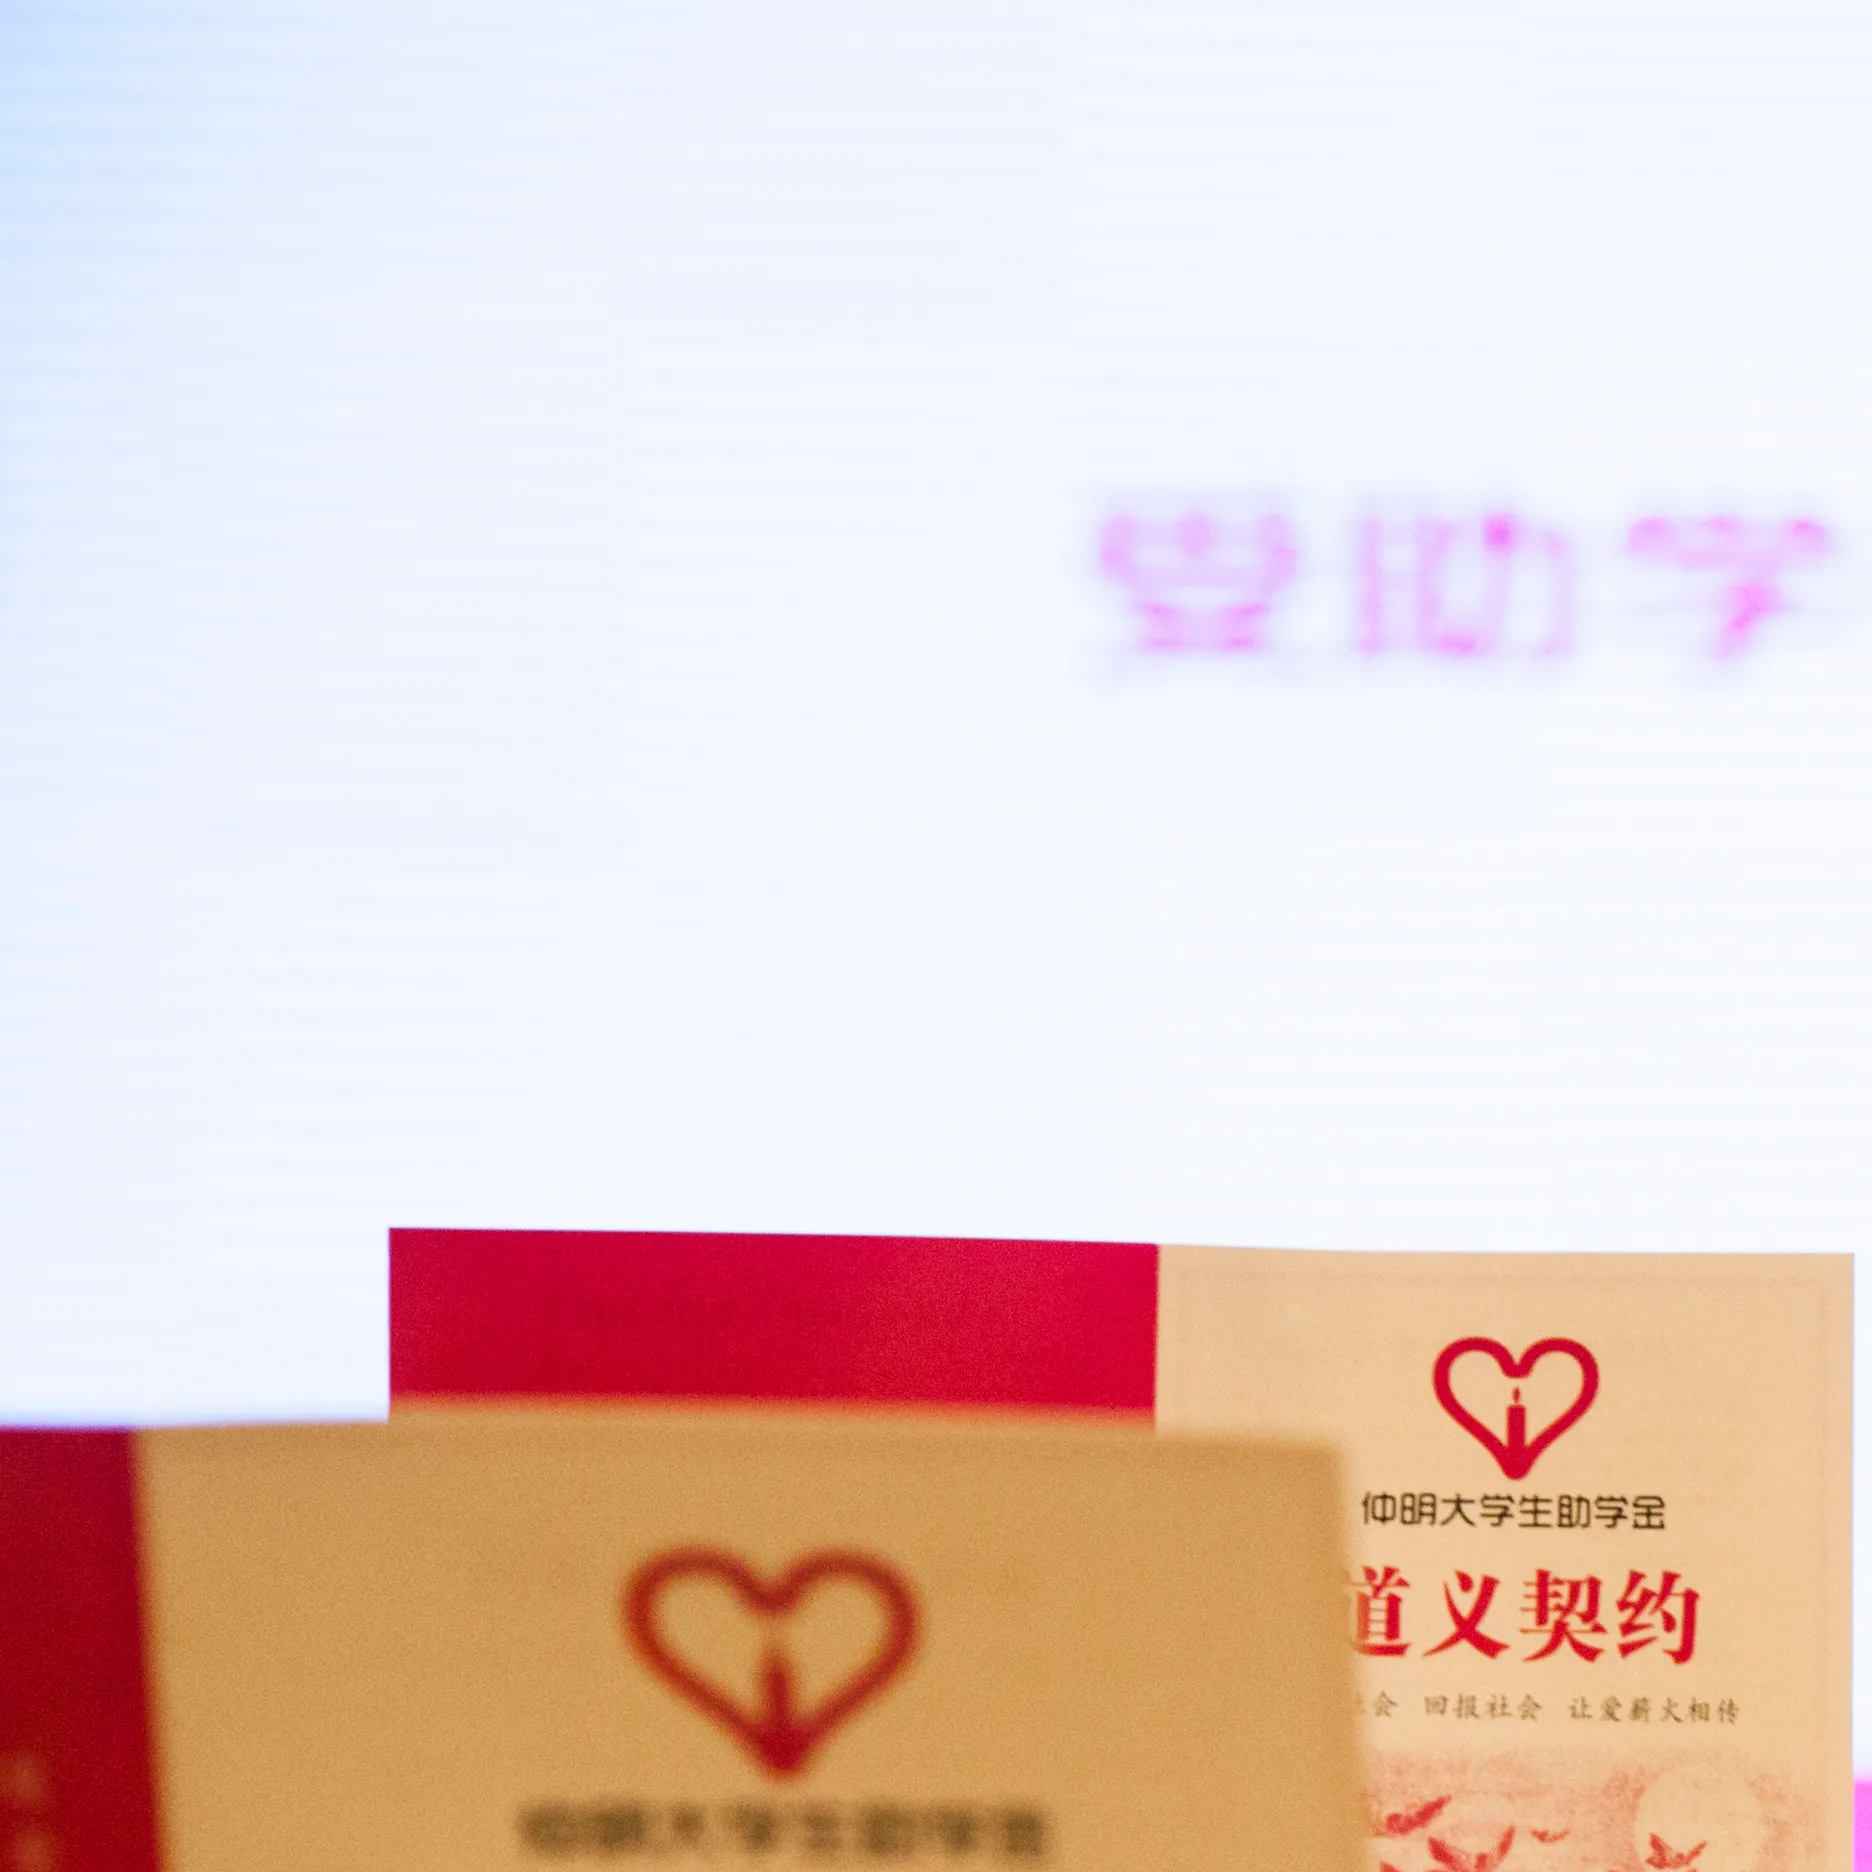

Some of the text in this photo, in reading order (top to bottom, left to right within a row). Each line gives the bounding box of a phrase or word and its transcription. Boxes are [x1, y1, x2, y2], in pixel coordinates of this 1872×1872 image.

[1360, 1492, 1666, 1531] 仲明大学生助学金
[1350, 1565, 1700, 1666] 道义契约
[1423, 1693, 1543, 1721] 回报社会
[1569, 1695, 1740, 1724] 让爱薪火相传
